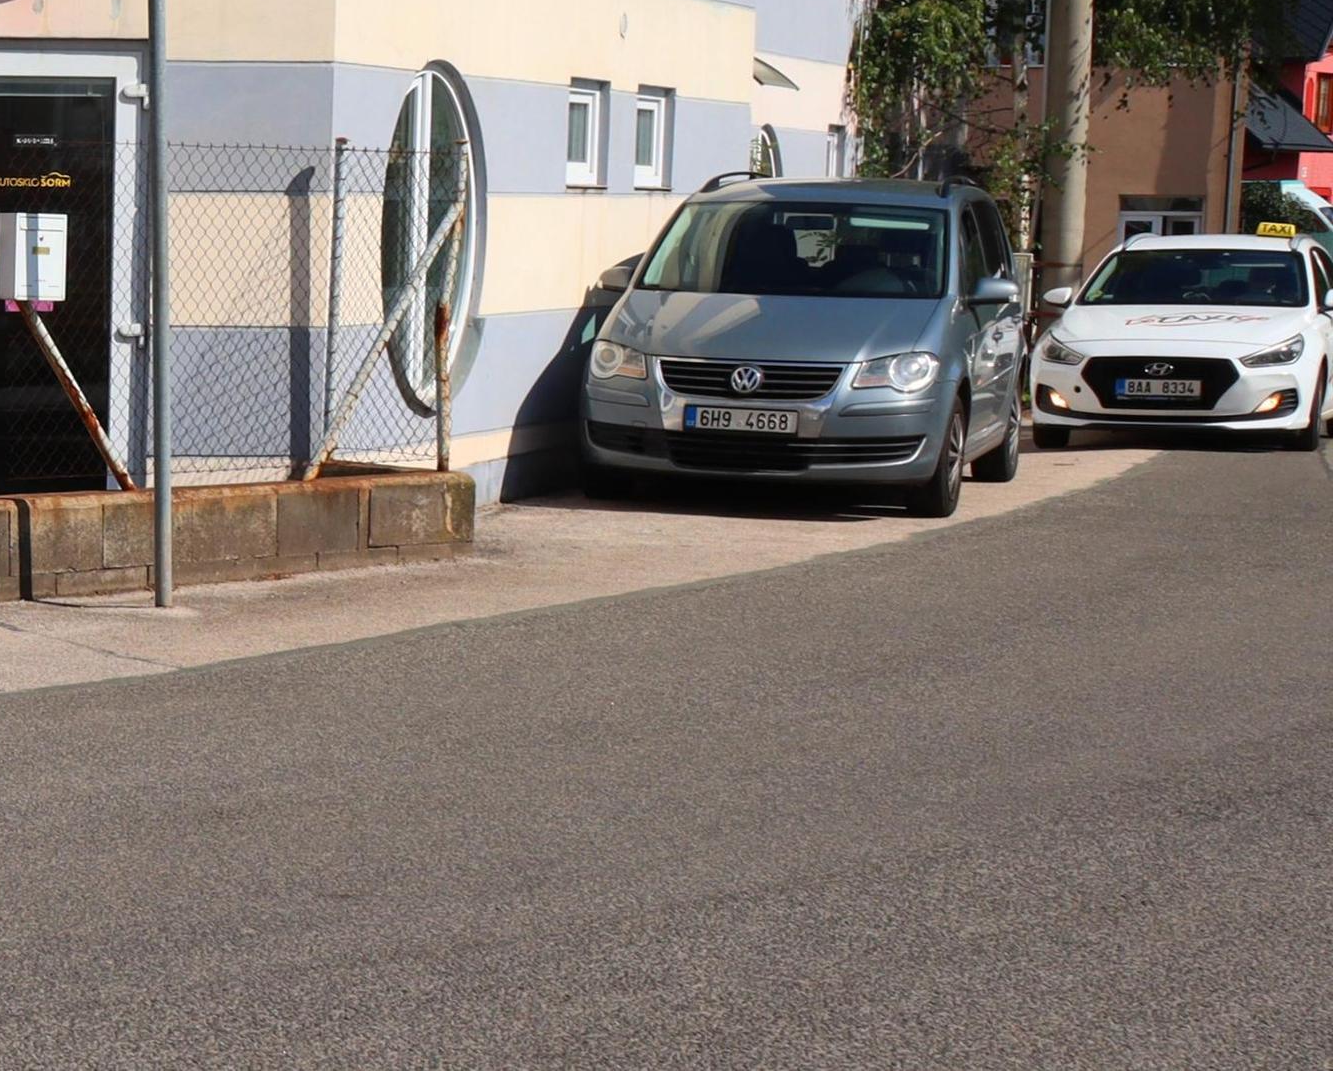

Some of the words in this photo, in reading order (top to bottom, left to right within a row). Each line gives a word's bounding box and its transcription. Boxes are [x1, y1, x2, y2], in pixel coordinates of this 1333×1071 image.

[1262, 224, 1292, 235] TAXI
[1127, 381, 1151, 393] 8AA
[1161, 381, 1195, 394] 8334
[699, 409, 732, 427] 6H9
[744, 411, 789, 430] 4668
